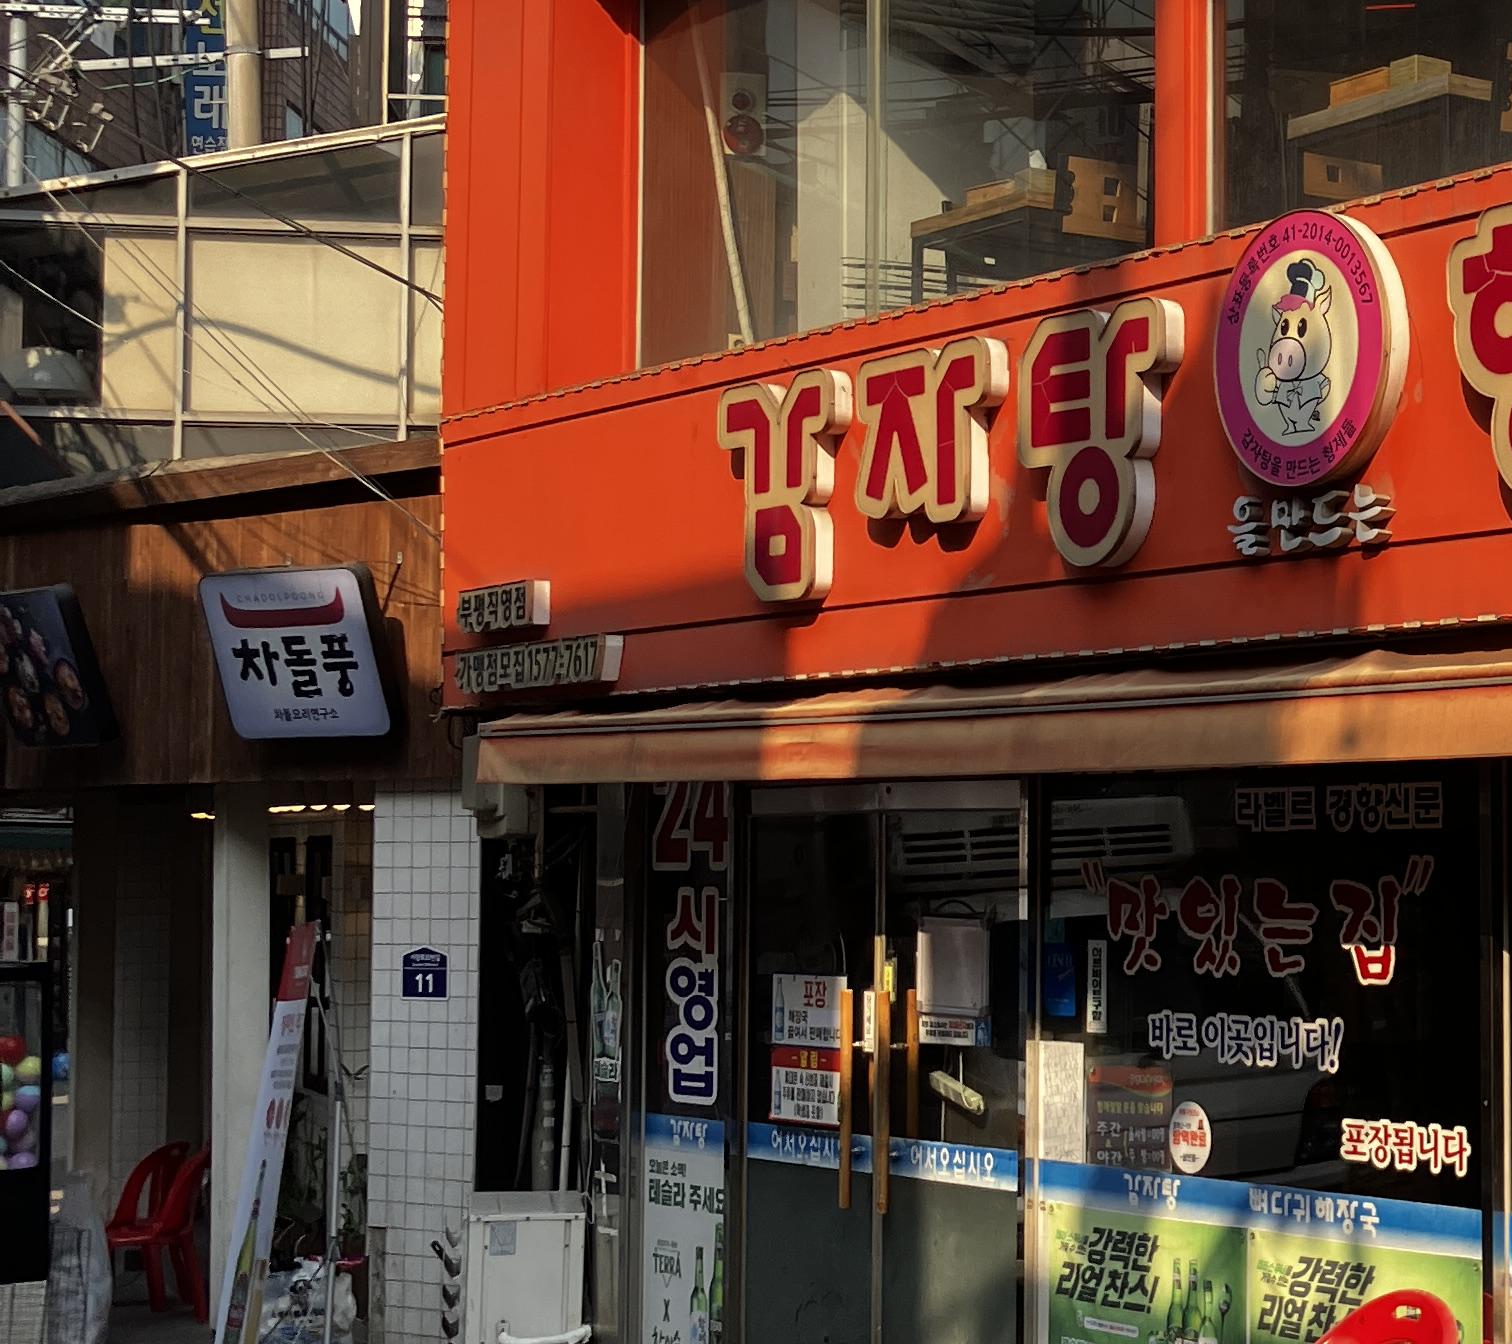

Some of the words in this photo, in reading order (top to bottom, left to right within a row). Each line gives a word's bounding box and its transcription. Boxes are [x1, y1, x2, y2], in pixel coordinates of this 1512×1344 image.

[717, 296, 1186, 602] 감자탕
[1284, 453, 1322, 480] 만드는
[460, 586, 526, 628] 부평직영점
[231, 632, 359, 698] 차돌풍
[459, 648, 526, 690] 가맹점모집
[415, 972, 434, 993] 11
[803, 979, 828, 1009] 포장
[664, 956, 719, 1107] 영업
[1147, 1010, 1200, 1060] 바로
[1201, 1011, 1345, 1075] 이곳입니다!
[669, 1118, 709, 1150] 감자탕
[770, 1130, 842, 1163] 어서오십시
[1338, 1117, 1471, 1178] 포장됩니다
[909, 1144, 996, 1183] 어서오십시오
[648, 1178, 686, 1209] 테슬라
[1122, 1173, 1182, 1211] 감자탕
[653, 1250, 682, 1280] TERRA
[1088, 1226, 1161, 1274] 강력한
[1055, 1260, 1106, 1305] 리얼
[1288, 1255, 1377, 1307] 강력한
[1257, 1293, 1309, 1340] 리얼
